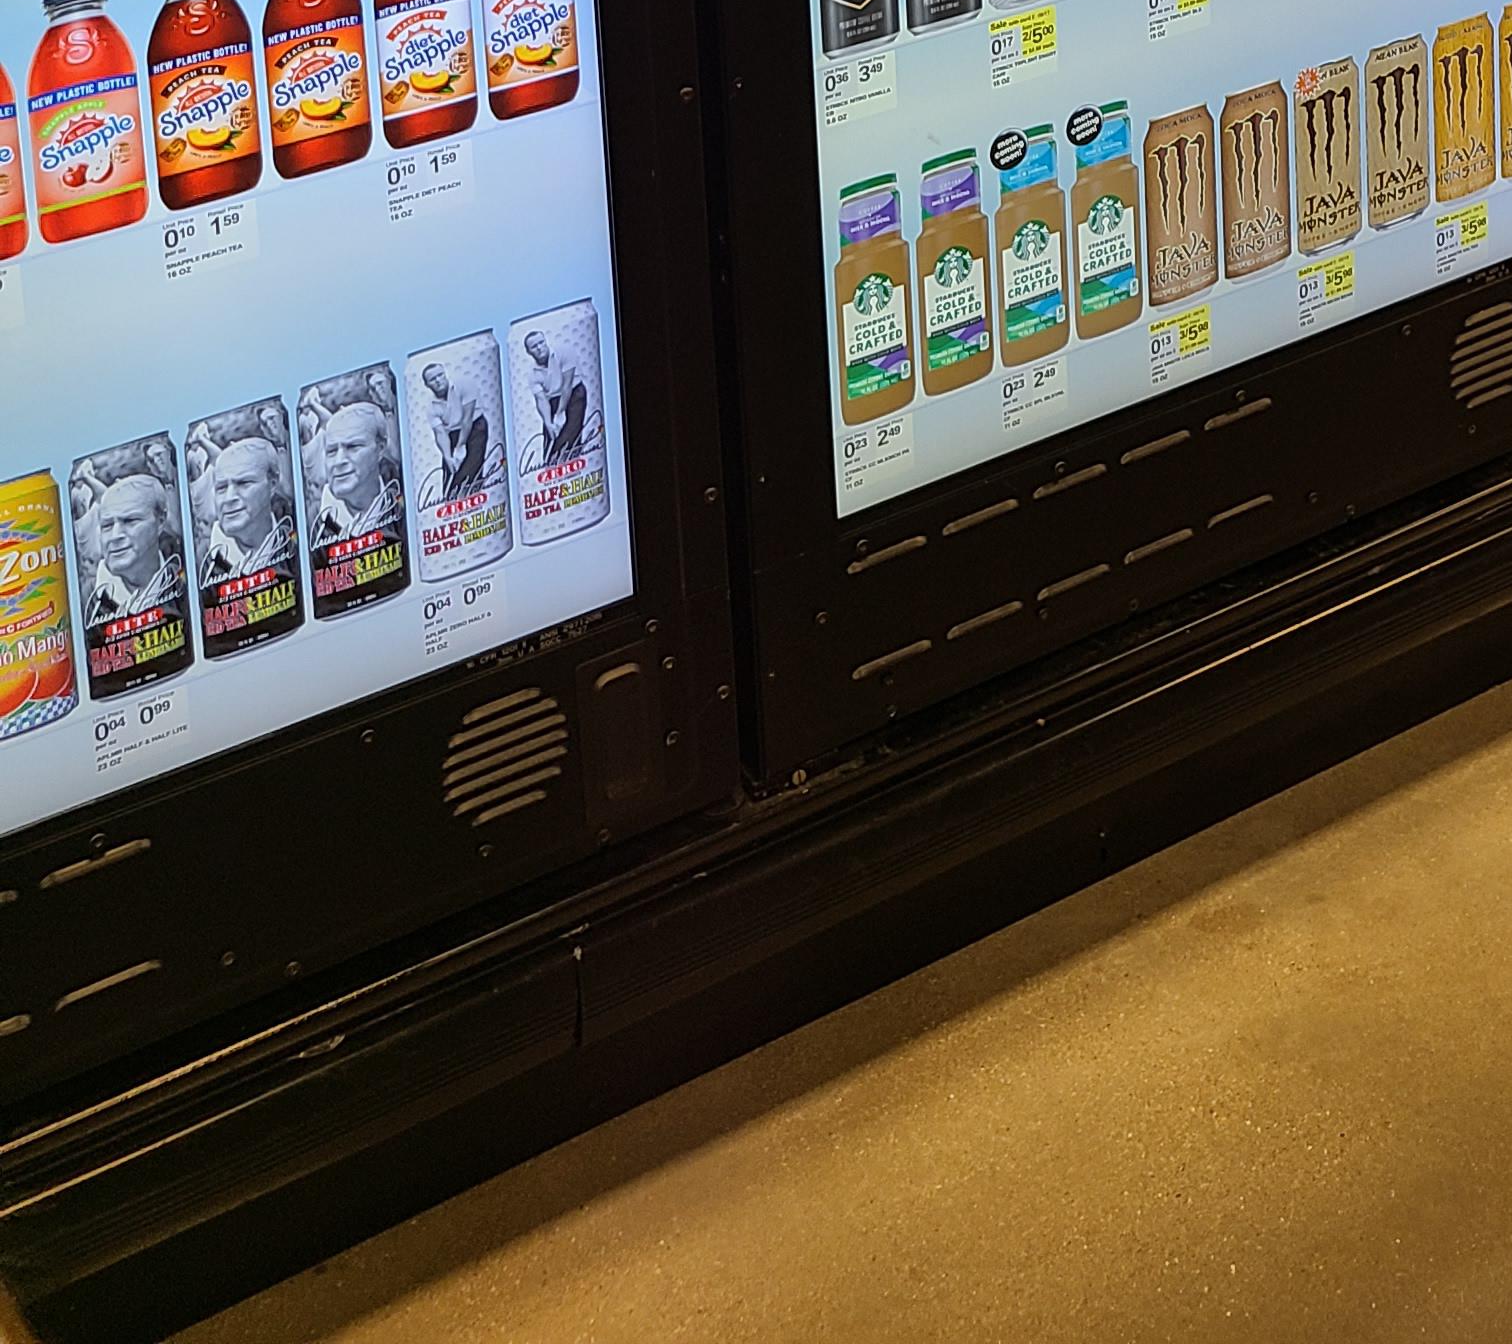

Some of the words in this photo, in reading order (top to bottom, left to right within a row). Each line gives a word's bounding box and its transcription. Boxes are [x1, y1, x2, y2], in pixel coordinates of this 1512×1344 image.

[490, 2, 569, 53] Snapple
[508, 7, 539, 29] diet
[385, 28, 466, 81] Snapple
[404, 37, 437, 57] diet
[30, 95, 53, 110] NEW
[56, 85, 94, 104] PLASTIC
[97, 75, 136, 94] BOTTLE!
[274, 52, 360, 107] Snapple
[159, 81, 249, 137] Snapple
[40, 115, 134, 170] Snapple
[1373, 156, 1424, 193] JAVA
[1303, 181, 1356, 218] JAVA
[930, 300, 982, 327] CRAFTED
[849, 328, 903, 354] CRAFTED
[855, 325, 885, 343] COLD
[328, 534, 384, 557] LITE
[219, 571, 276, 596] LITE
